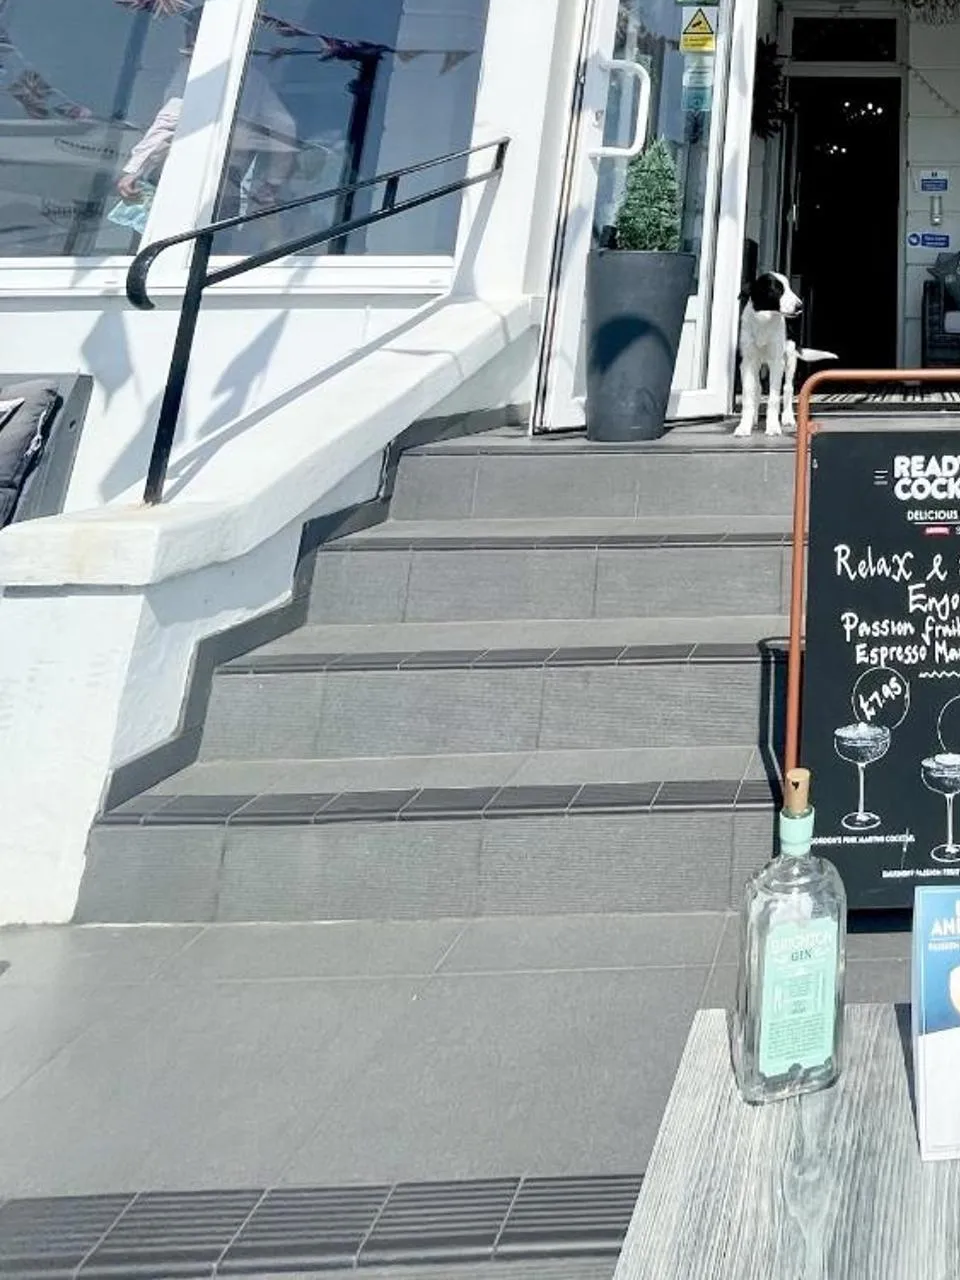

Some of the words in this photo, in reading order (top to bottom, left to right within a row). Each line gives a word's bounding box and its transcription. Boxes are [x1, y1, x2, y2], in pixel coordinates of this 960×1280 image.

[907, 509, 958, 521] DELICIOUS
[834, 544, 915, 582] Relax
[841, 612, 915, 642] Passion
[855, 643, 927, 667] Espresso
[791, 948, 813, 962] GIN
